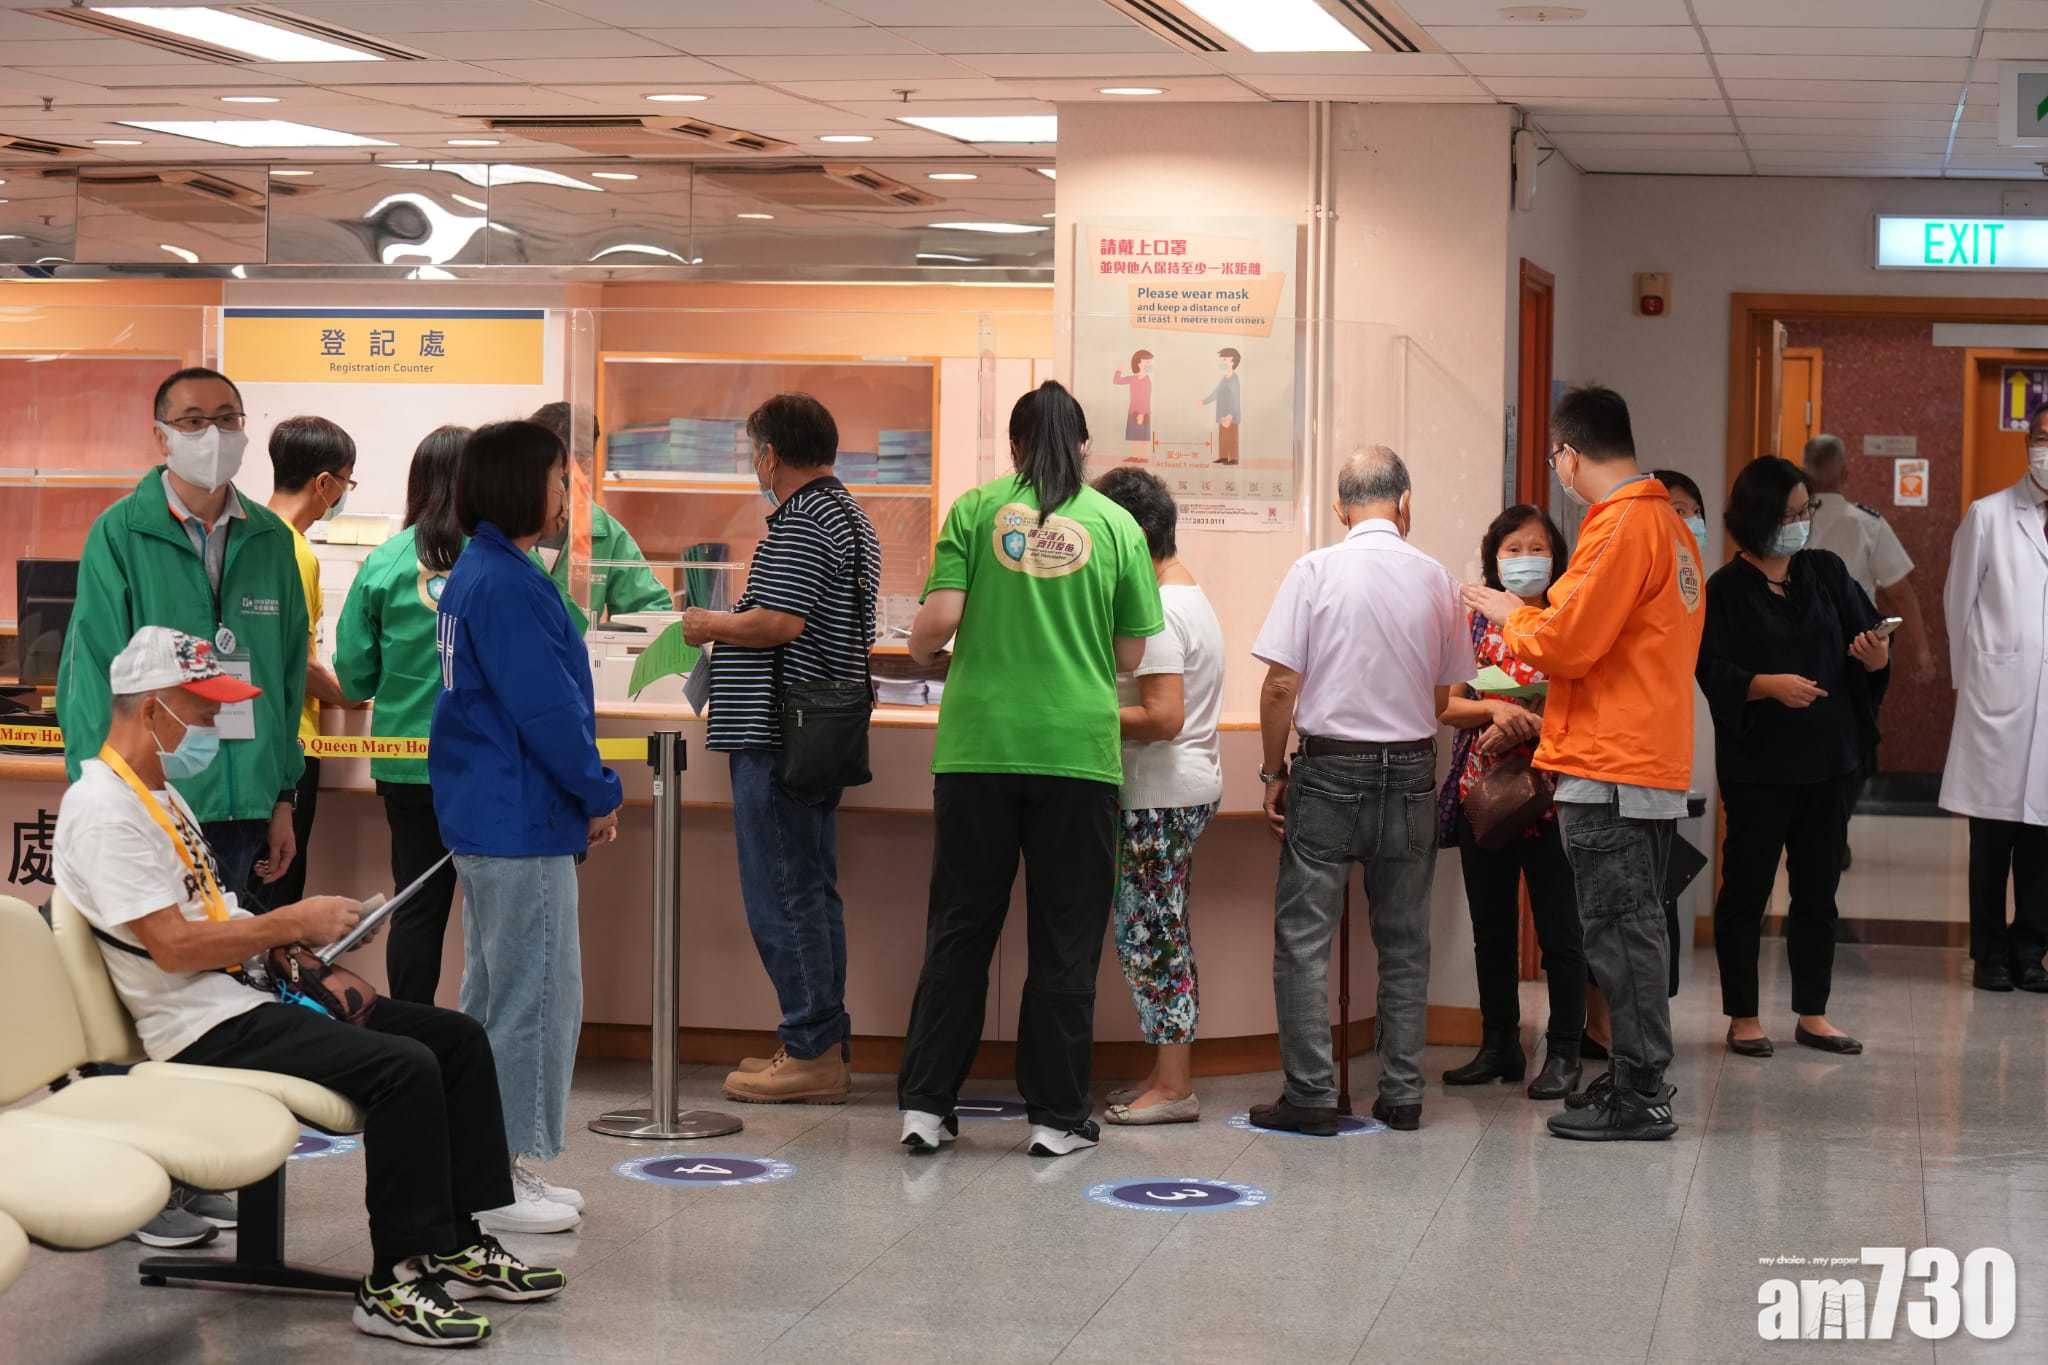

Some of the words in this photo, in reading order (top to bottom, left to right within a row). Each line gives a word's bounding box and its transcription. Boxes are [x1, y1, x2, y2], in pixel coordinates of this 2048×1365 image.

[1100, 239, 1187, 256] 請戴上口罩
[1924, 223, 2004, 265] EXIT
[1100, 261, 1262, 276] 並與他人保持至少一米距離
[1137, 287, 1178, 300] Please
[1182, 290, 1213, 300] wear
[1215, 288, 1249, 300] mask
[1137, 303, 1155, 312] and
[1157, 303, 1180, 314] keep
[1189, 303, 1229, 312] distance
[1231, 303, 1241, 312] of
[1181, 316, 1209, 325] metre
[320, 329, 445, 357] 登記處
[329, 362, 391, 374] Registration
[393, 362, 434, 373] Counter
[0, 728, 38, 745] Mary
[42, 729, 65, 742] Ho
[311, 738, 357, 753] Queen
[362, 739, 401, 756] Mary
[405, 740, 428, 753] Ho
[673, 1163, 733, 1174] 4
[1145, 1188, 1209, 1201] 3
